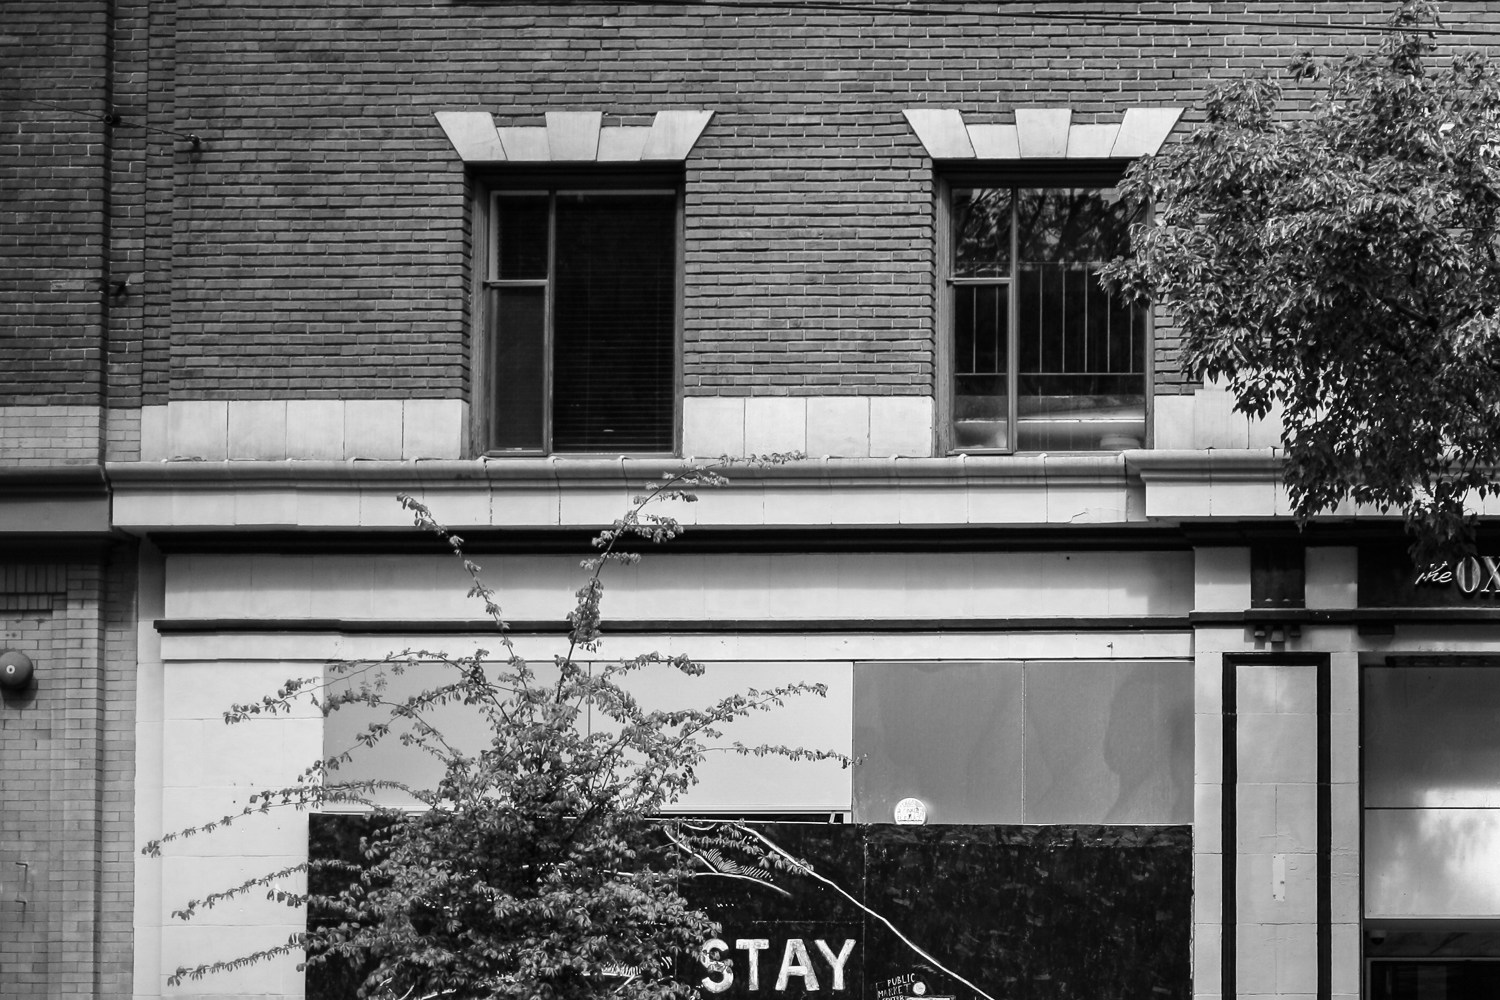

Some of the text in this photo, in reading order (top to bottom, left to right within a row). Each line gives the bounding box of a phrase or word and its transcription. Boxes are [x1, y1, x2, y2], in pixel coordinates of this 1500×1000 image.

[700, 938, 857, 994] STAY
[887, 972, 916, 987] PUBLIC
[878, 983, 912, 998] MARKET
